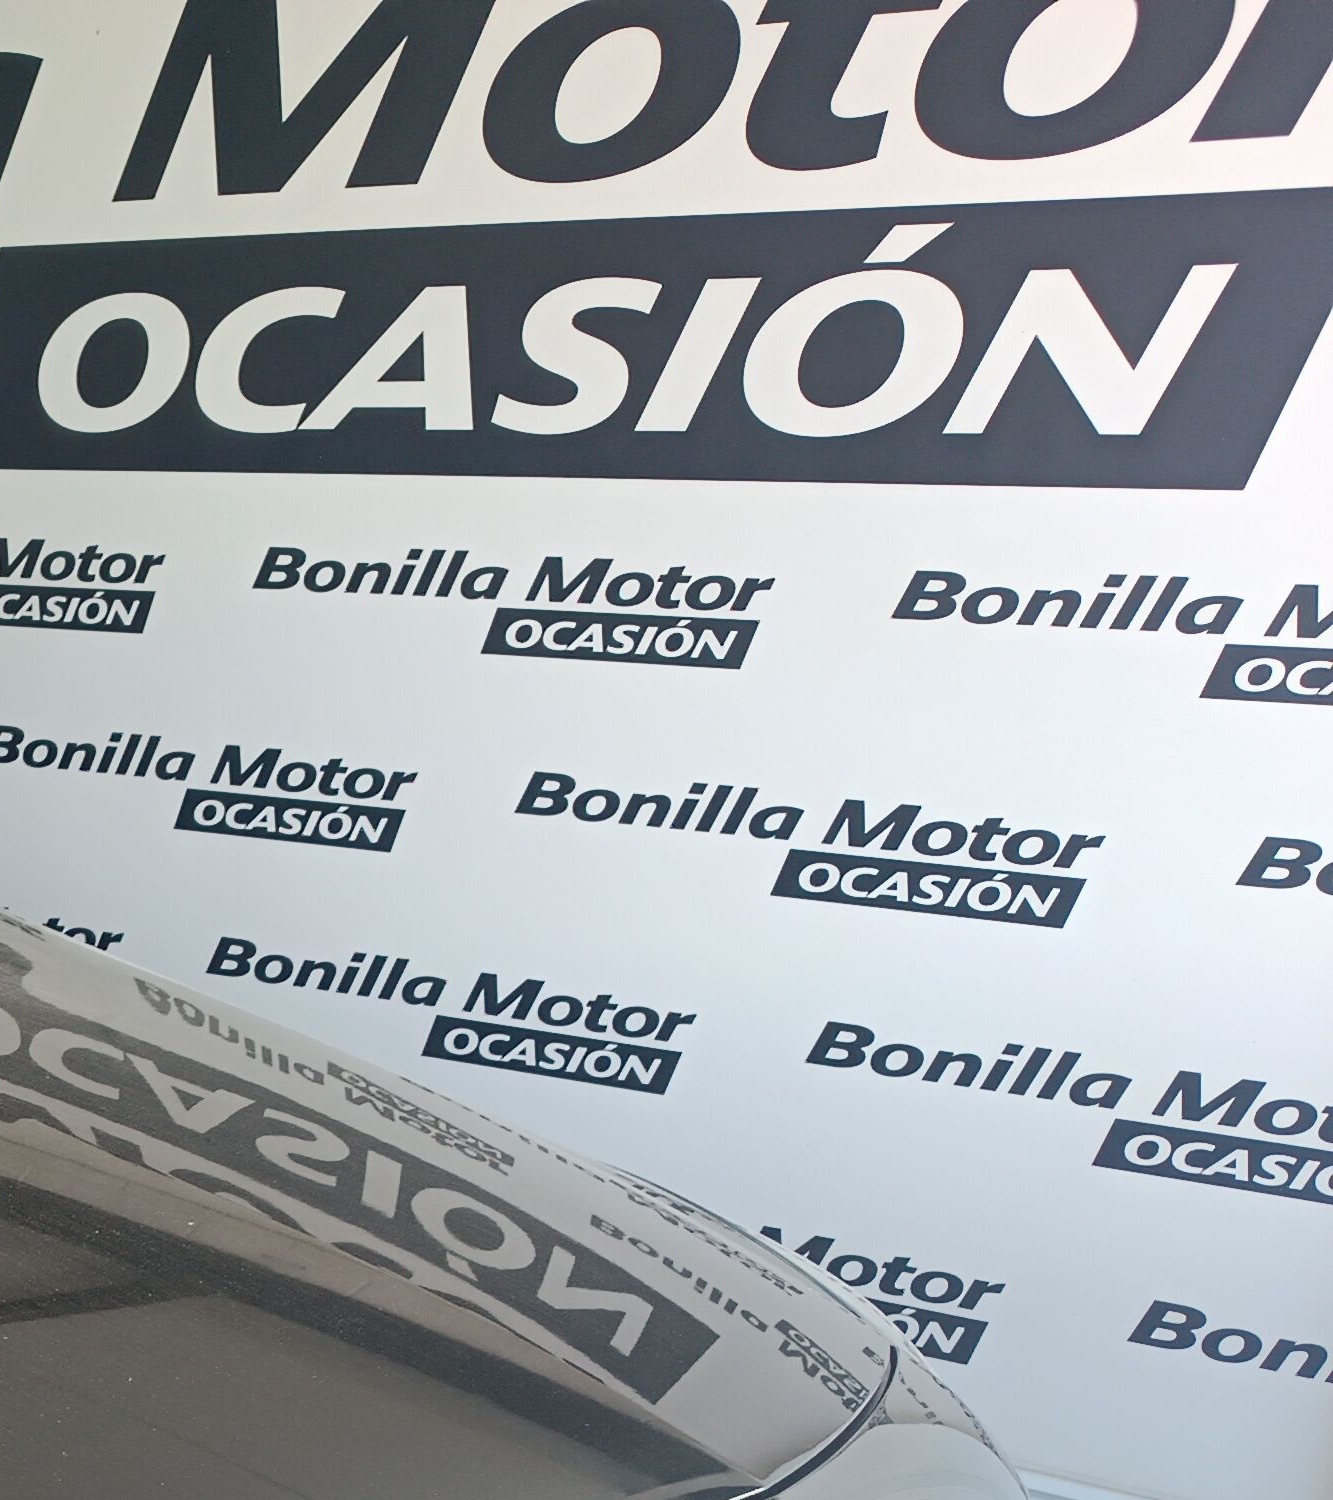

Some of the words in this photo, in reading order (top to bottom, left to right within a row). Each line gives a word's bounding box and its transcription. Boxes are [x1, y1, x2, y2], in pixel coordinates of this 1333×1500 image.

[37, 222, 1239, 436] OCASIÓN
[253, 546, 509, 600] Bonilla
[526, 556, 775, 612] Motor
[891, 570, 1244, 635] Bonilla
[505, 618, 738, 660] OCASIÓN
[211, 745, 418, 801] Motor
[193, 796, 389, 844] OCASIÓN
[515, 771, 805, 841] Bonilla
[822, 799, 1106, 870] Motor
[797, 861, 1060, 918] OCASIÓN
[206, 936, 448, 1007] Bonilla
[462, 972, 697, 1042] Motor
[443, 1027, 665, 1086] OCASIÓN
[805, 1021, 1133, 1110] Bonilla
